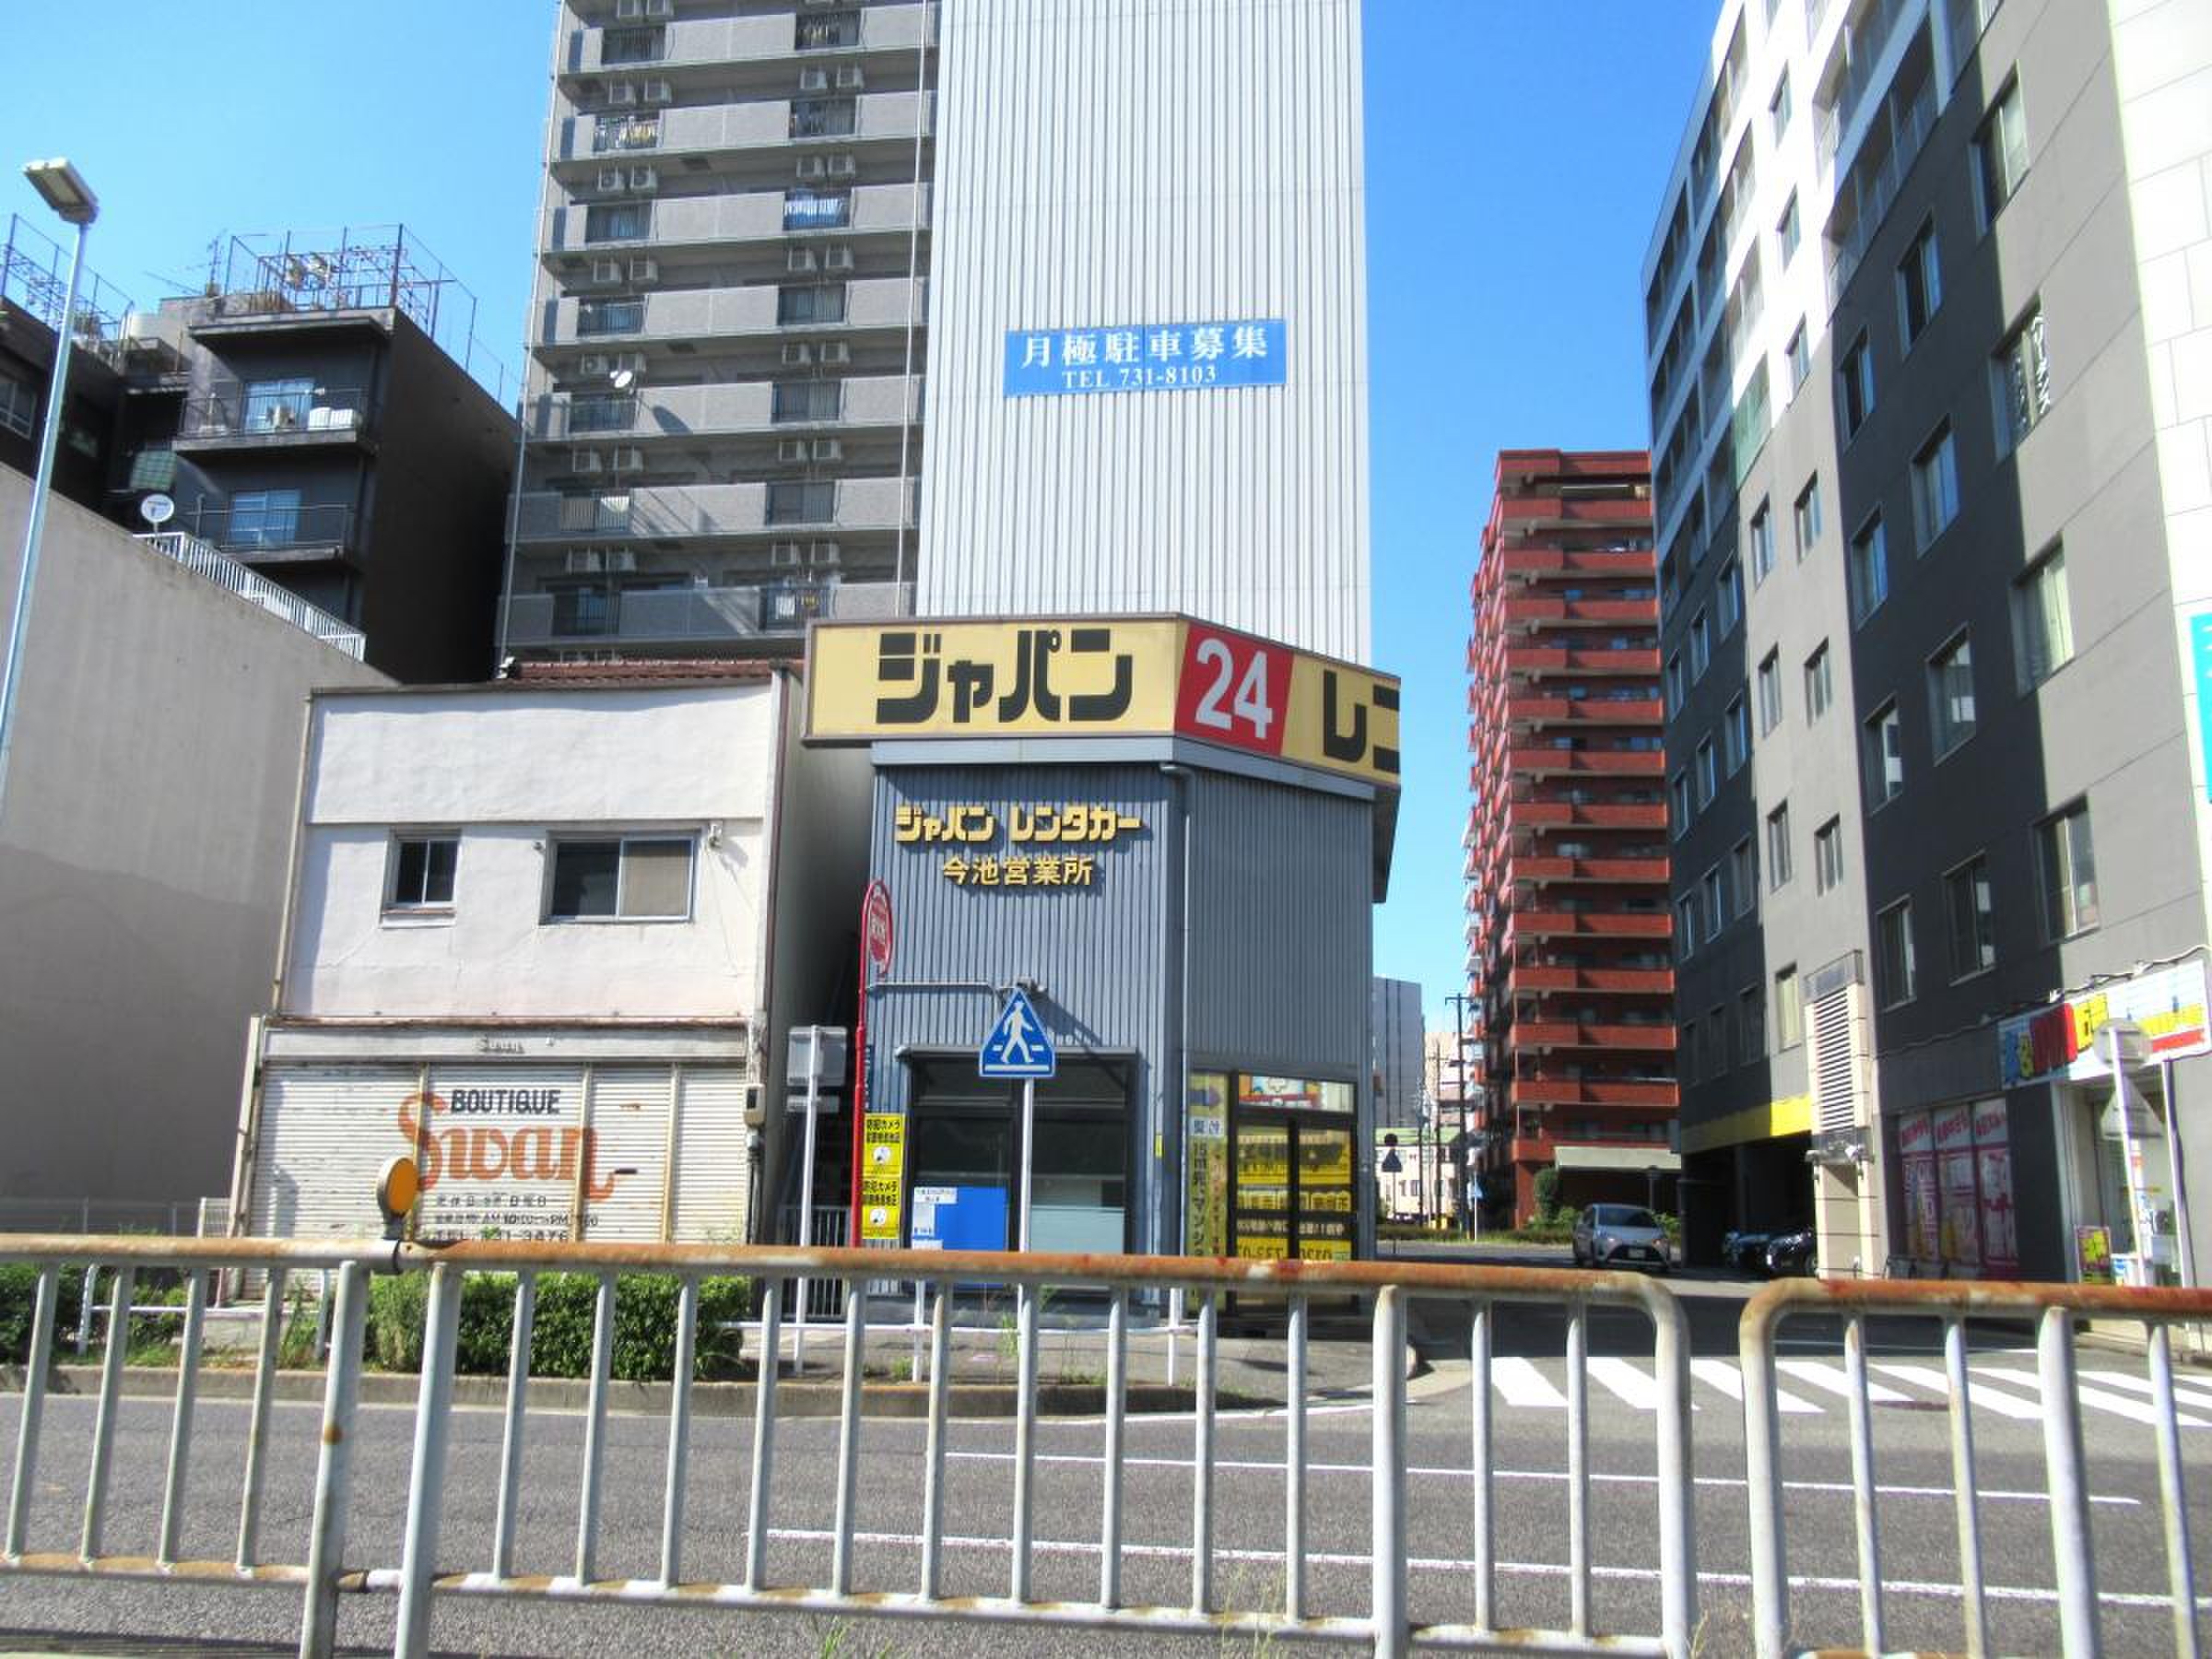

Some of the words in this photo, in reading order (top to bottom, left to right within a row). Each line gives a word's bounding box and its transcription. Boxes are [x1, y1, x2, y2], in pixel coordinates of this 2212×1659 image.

[1021, 326, 1267, 369] 月極駐車募集
[1063, 370, 1110, 389] TEL
[1119, 365, 1217, 386] 731-8103
[876, 629, 1134, 724] ジャパン
[1194, 638, 1274, 739] 24
[894, 805, 994, 841] ジャパン
[1009, 805, 1143, 841] レンタカー
[943, 855, 1092, 886] 今池営業所
[451, 1089, 561, 1115] BOUTIQUE
